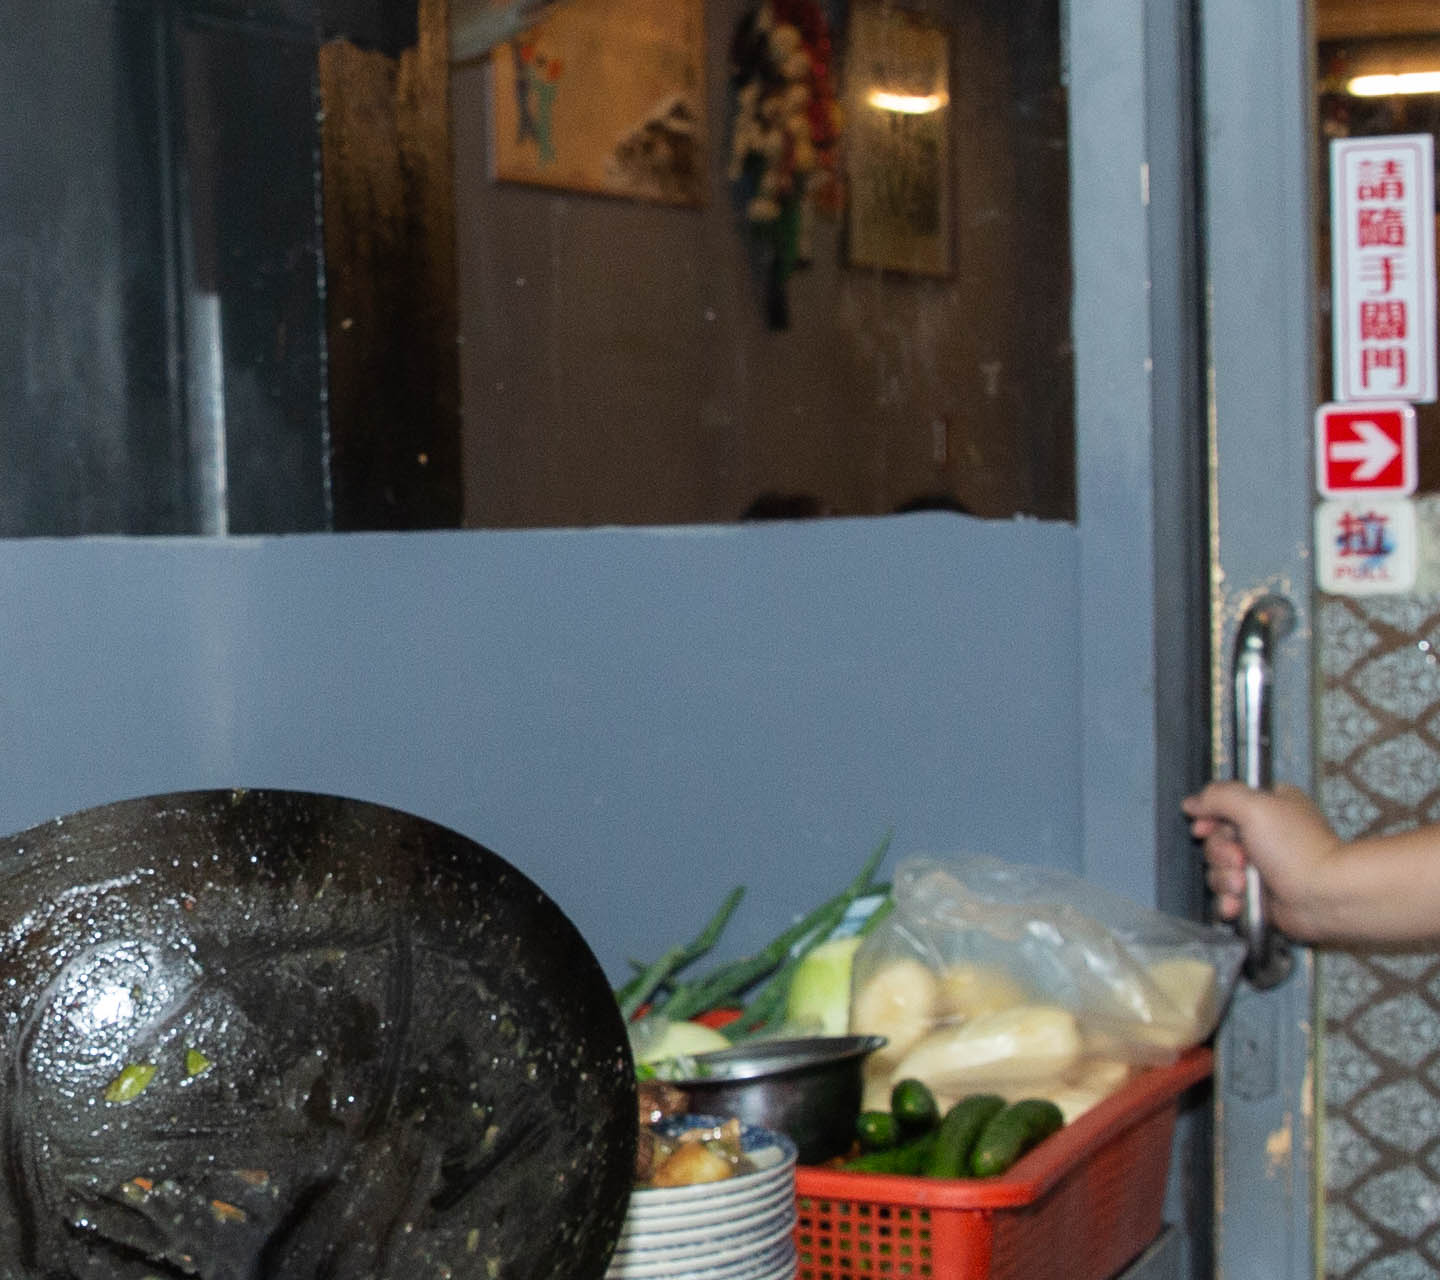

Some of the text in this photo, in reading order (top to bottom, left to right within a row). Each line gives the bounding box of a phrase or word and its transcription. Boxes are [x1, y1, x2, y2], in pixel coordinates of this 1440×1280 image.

[1357, 159, 1408, 388] 請隨手關門
[1336, 511, 1390, 557] 拉
